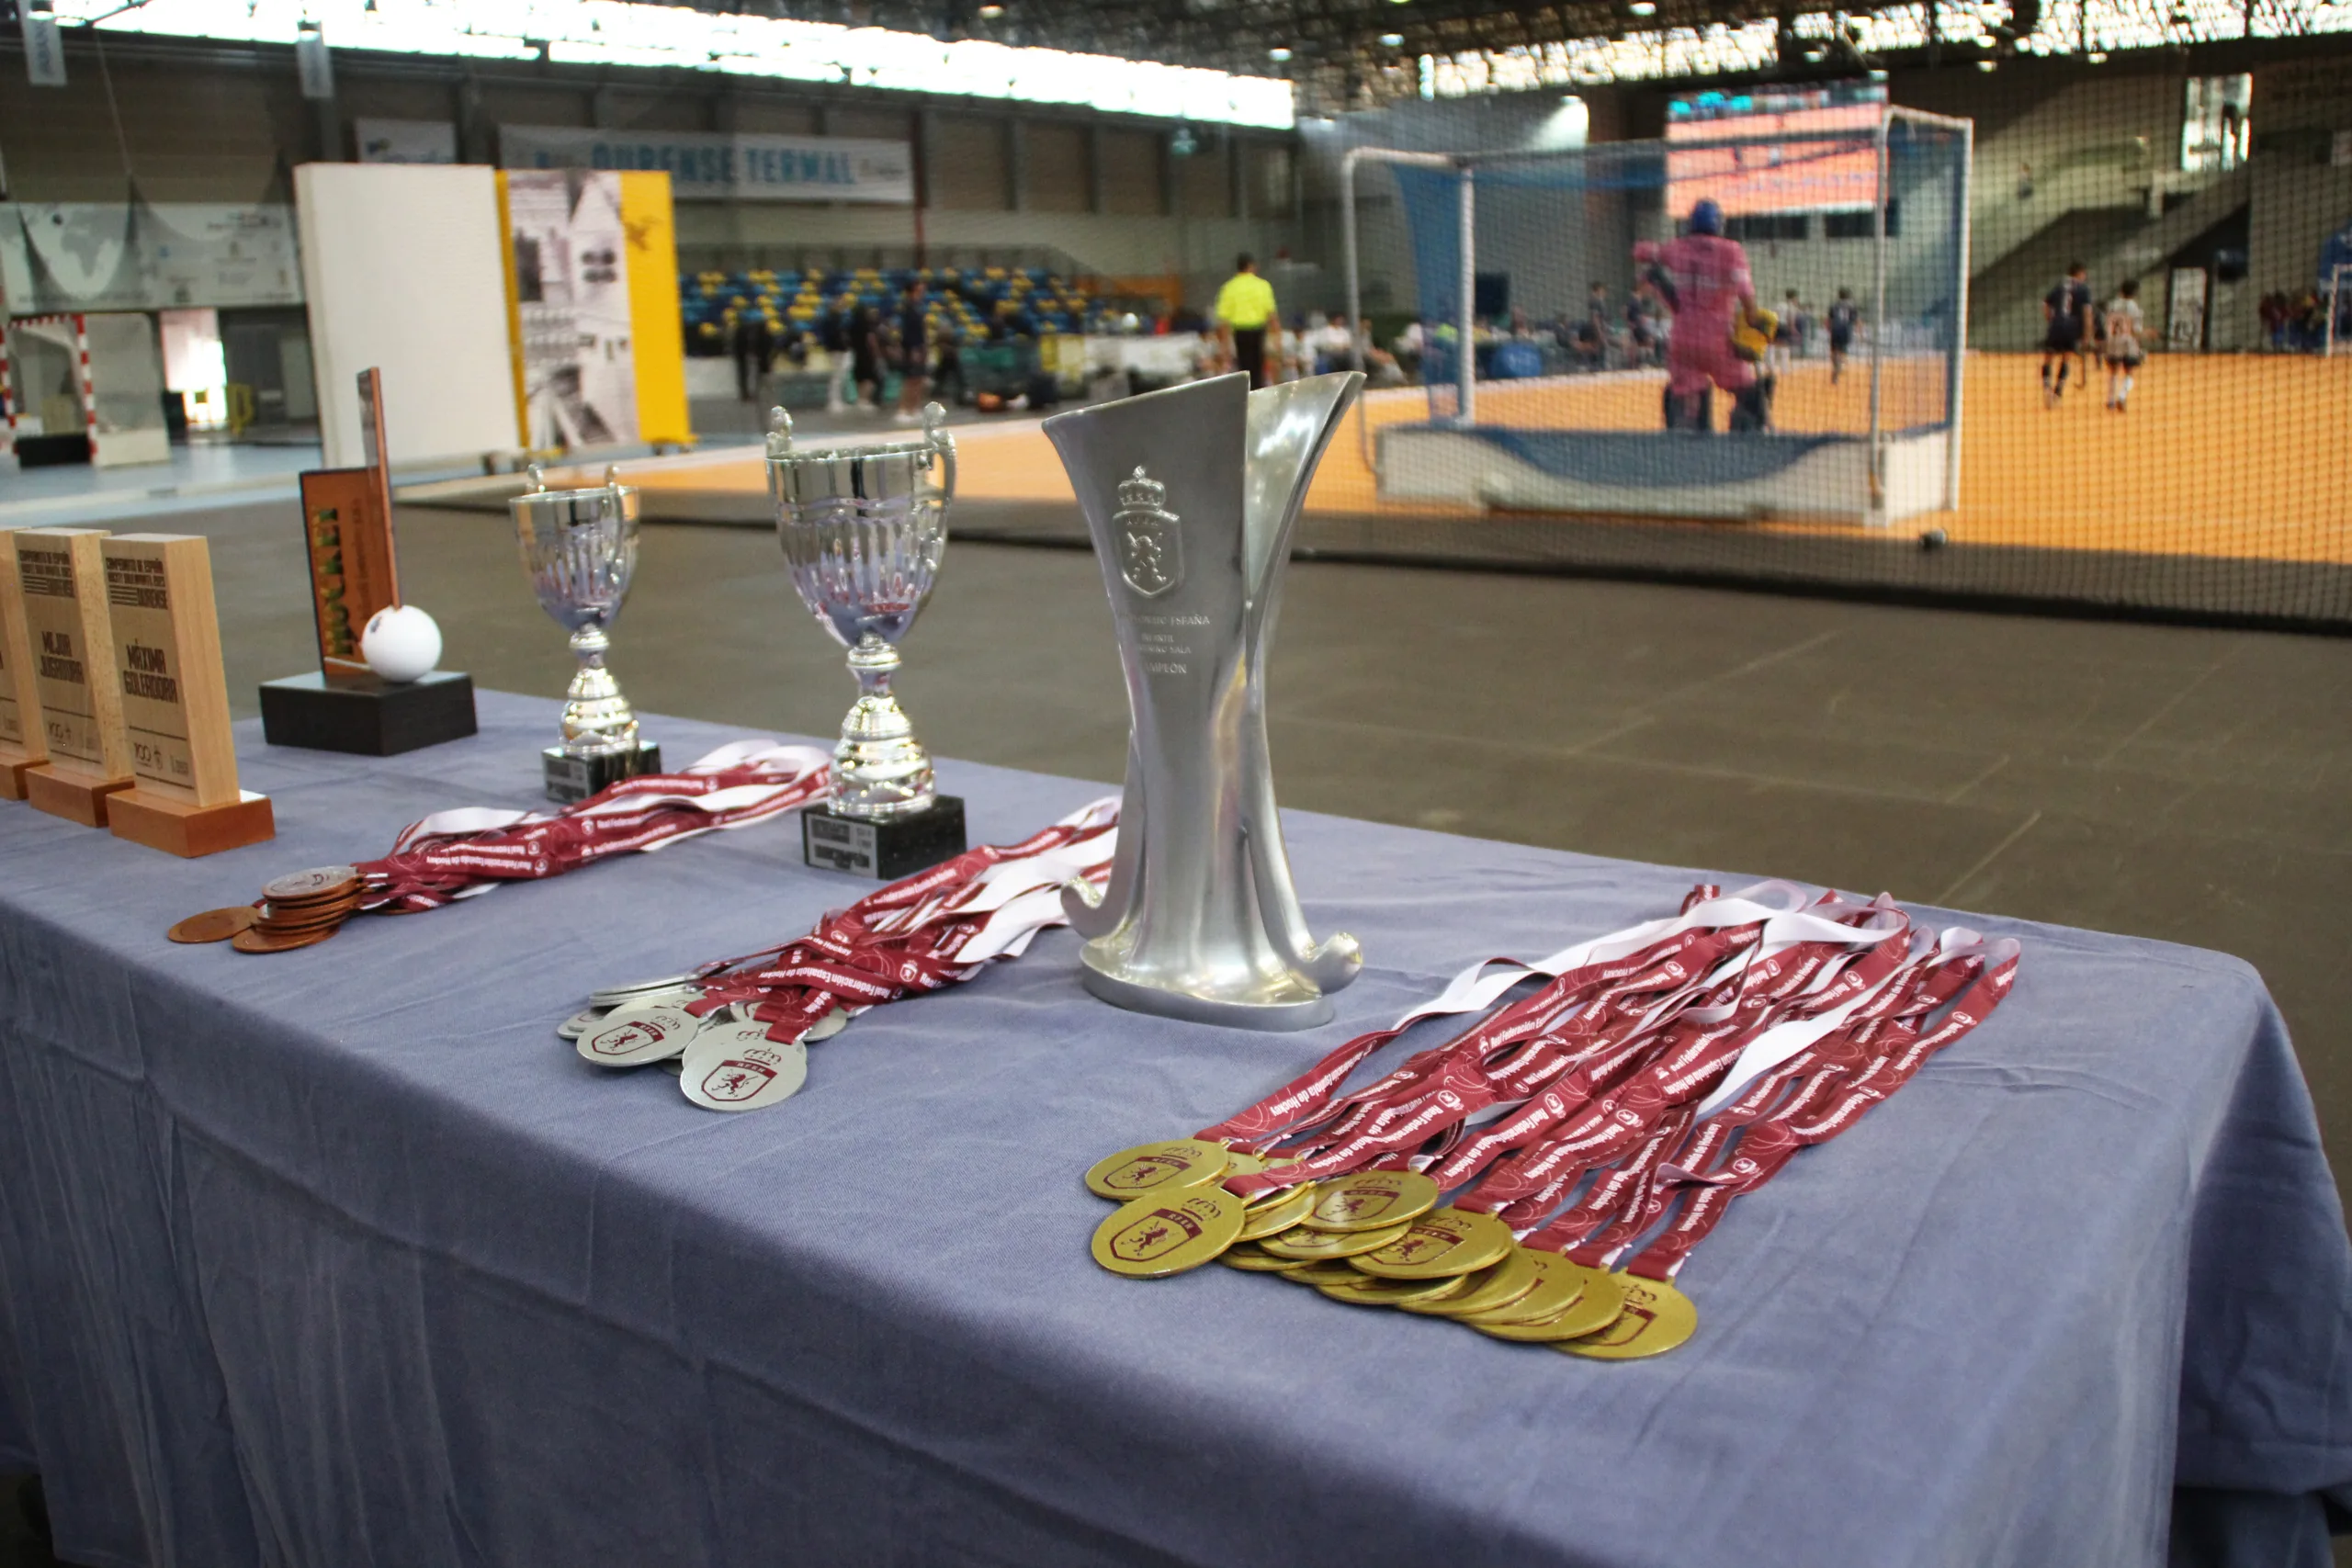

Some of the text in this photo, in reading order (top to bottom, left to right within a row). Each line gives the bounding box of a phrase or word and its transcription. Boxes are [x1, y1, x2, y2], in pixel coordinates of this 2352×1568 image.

[823, 940, 852, 955] Hockey
[797, 968, 831, 983] Española
[831, 973, 875, 995] Federación
[1501, 1020, 1534, 1040] Federación
[1295, 1089, 1311, 1103] de
[1270, 1096, 1301, 1116] Hockey
[1421, 1104, 1443, 1120] Real
[1529, 1107, 1549, 1125] Real
[1340, 1147, 1354, 1157] de
[1466, 1146, 1482, 1159] de
[1308, 1154, 1344, 1167] Hockey
[1443, 1155, 1476, 1177] Hockey
